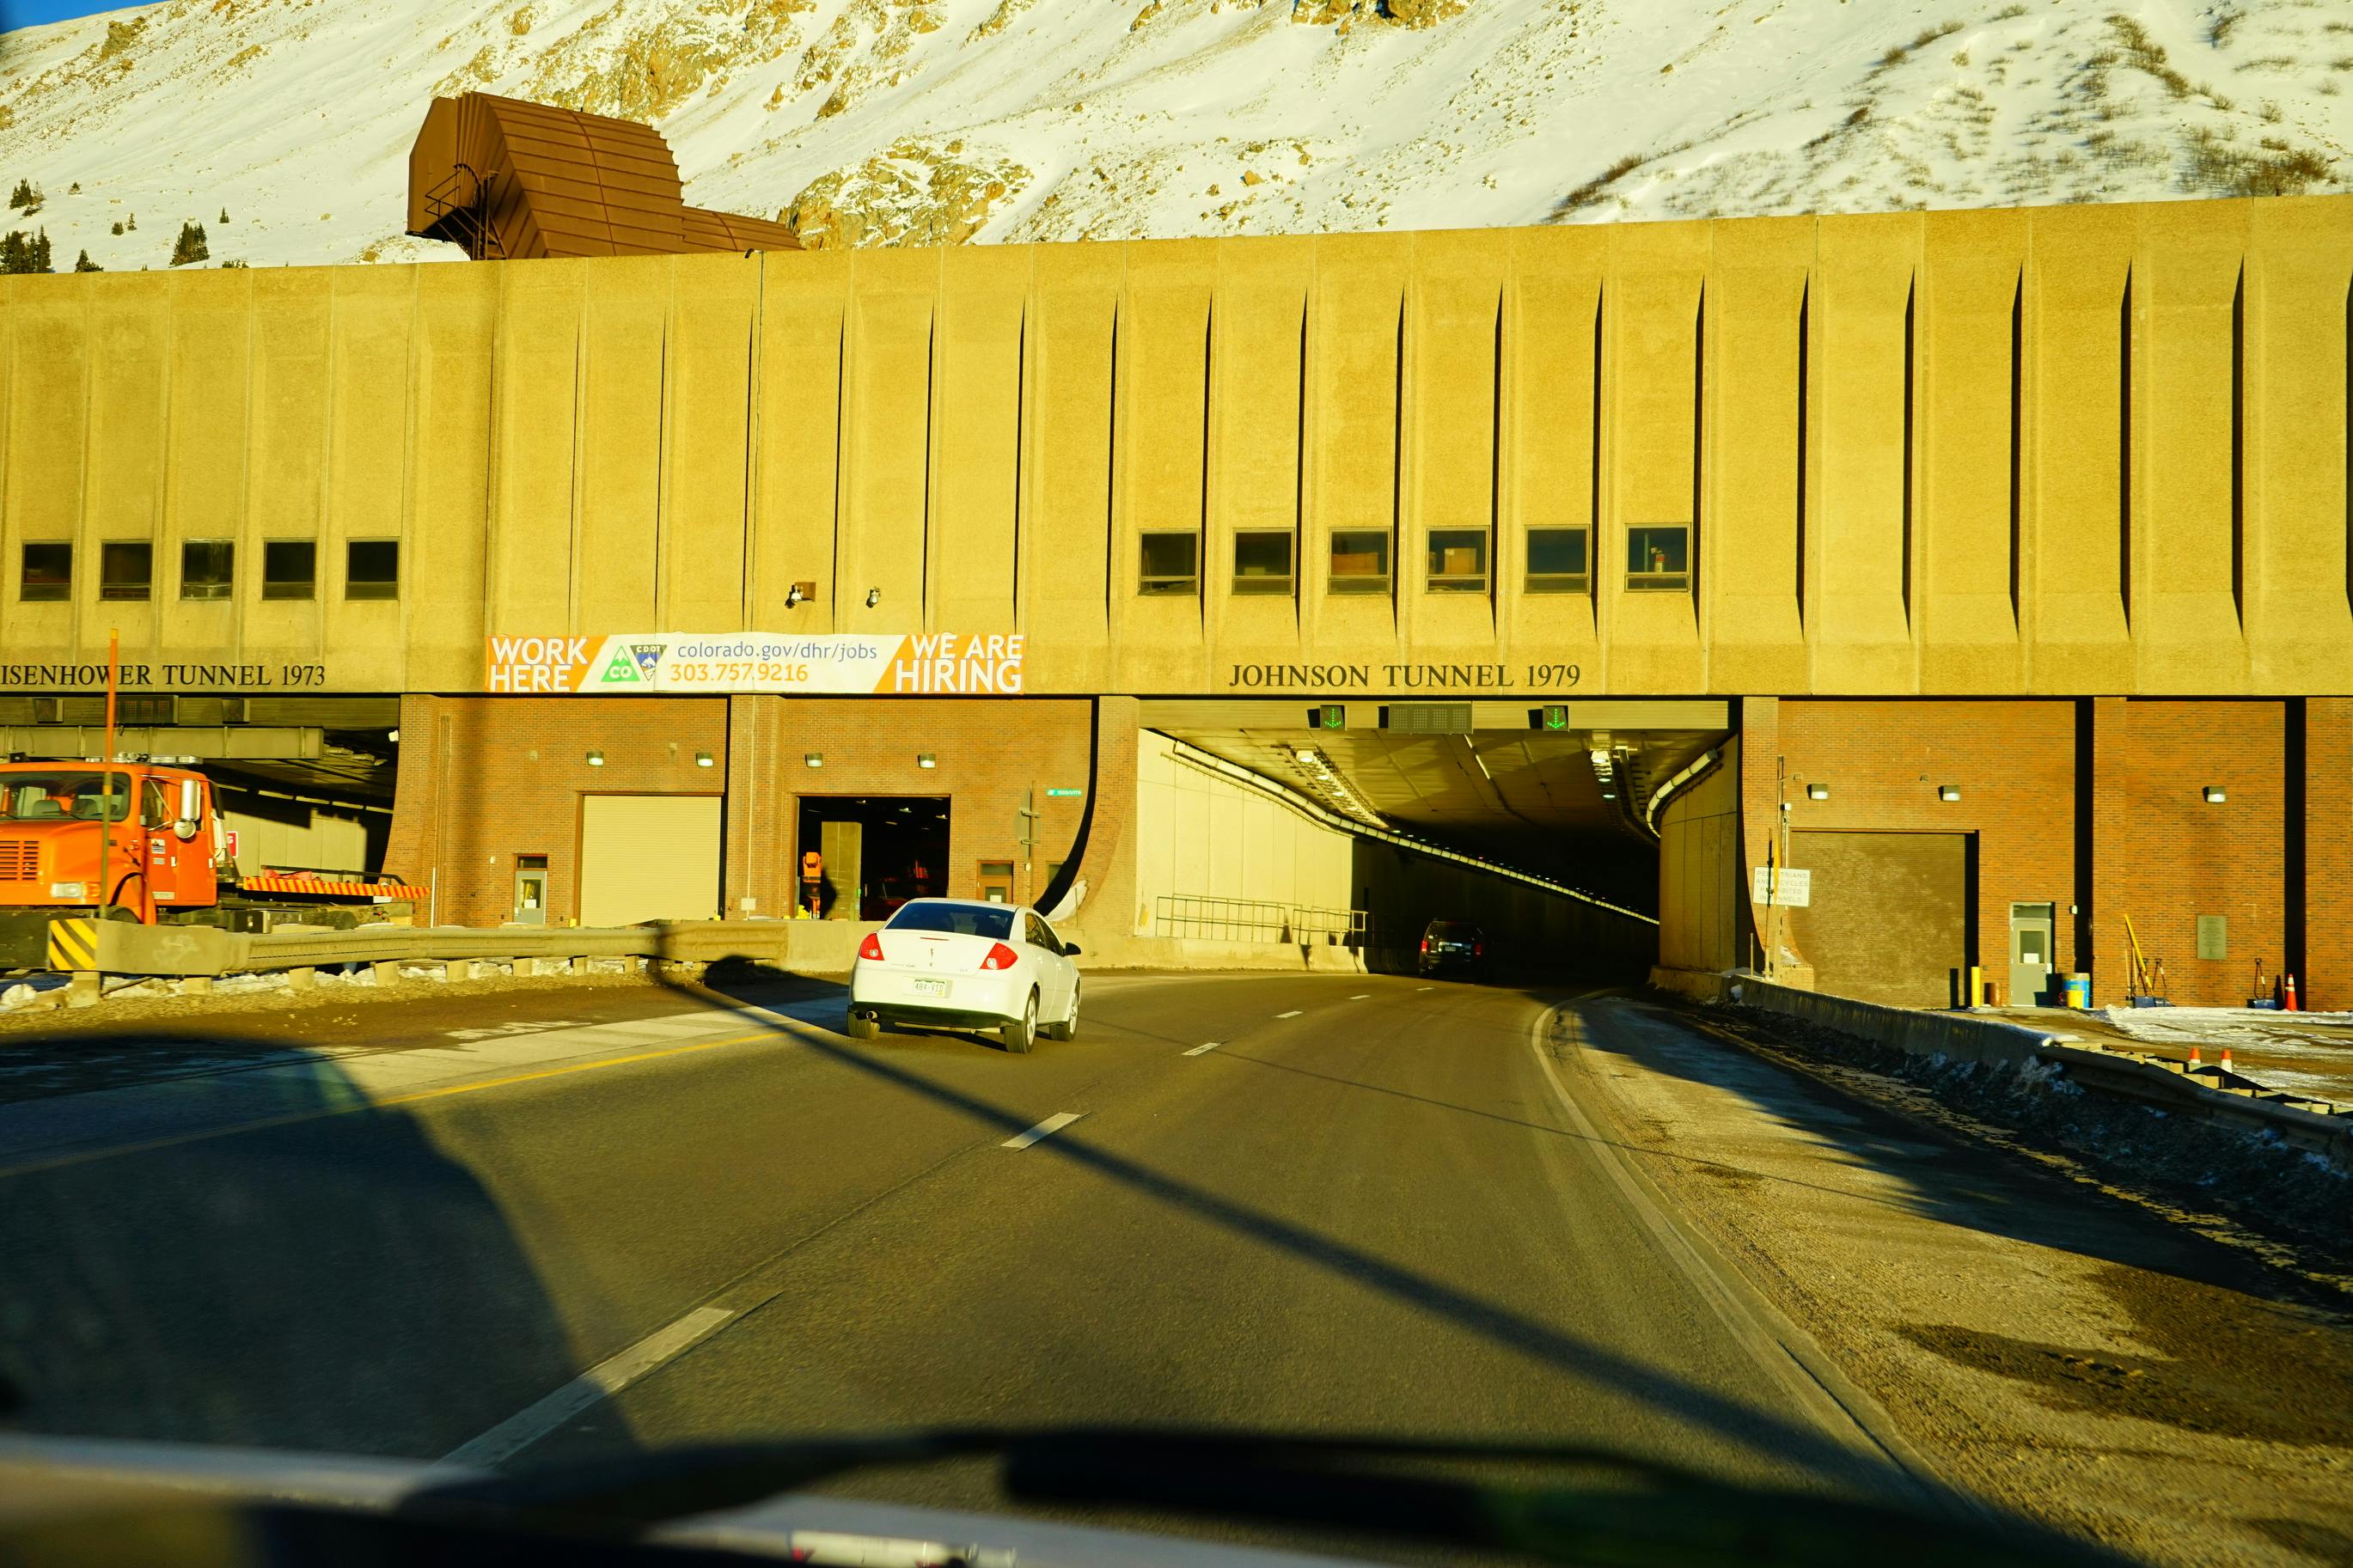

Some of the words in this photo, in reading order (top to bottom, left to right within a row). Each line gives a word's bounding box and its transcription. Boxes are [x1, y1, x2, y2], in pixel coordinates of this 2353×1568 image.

[492, 638, 589, 665] WORK
[677, 641, 877, 662] colorado.gov/dhr/jobs
[911, 632, 957, 660] WE
[965, 634, 1024, 660] ARE
[162, 665, 272, 686] TUNNEL
[282, 665, 326, 686] 1973
[489, 664, 571, 692] HERE
[608, 665, 633, 679] CO
[669, 662, 809, 681] 303.757.9216
[895, 659, 1022, 693] HIRING
[1229, 664, 1370, 687] JOHNSON
[1383, 664, 1514, 687] TUNNEL
[1528, 664, 1581, 687] 1979
[1757, 870, 1807, 879] PEETRIANS
